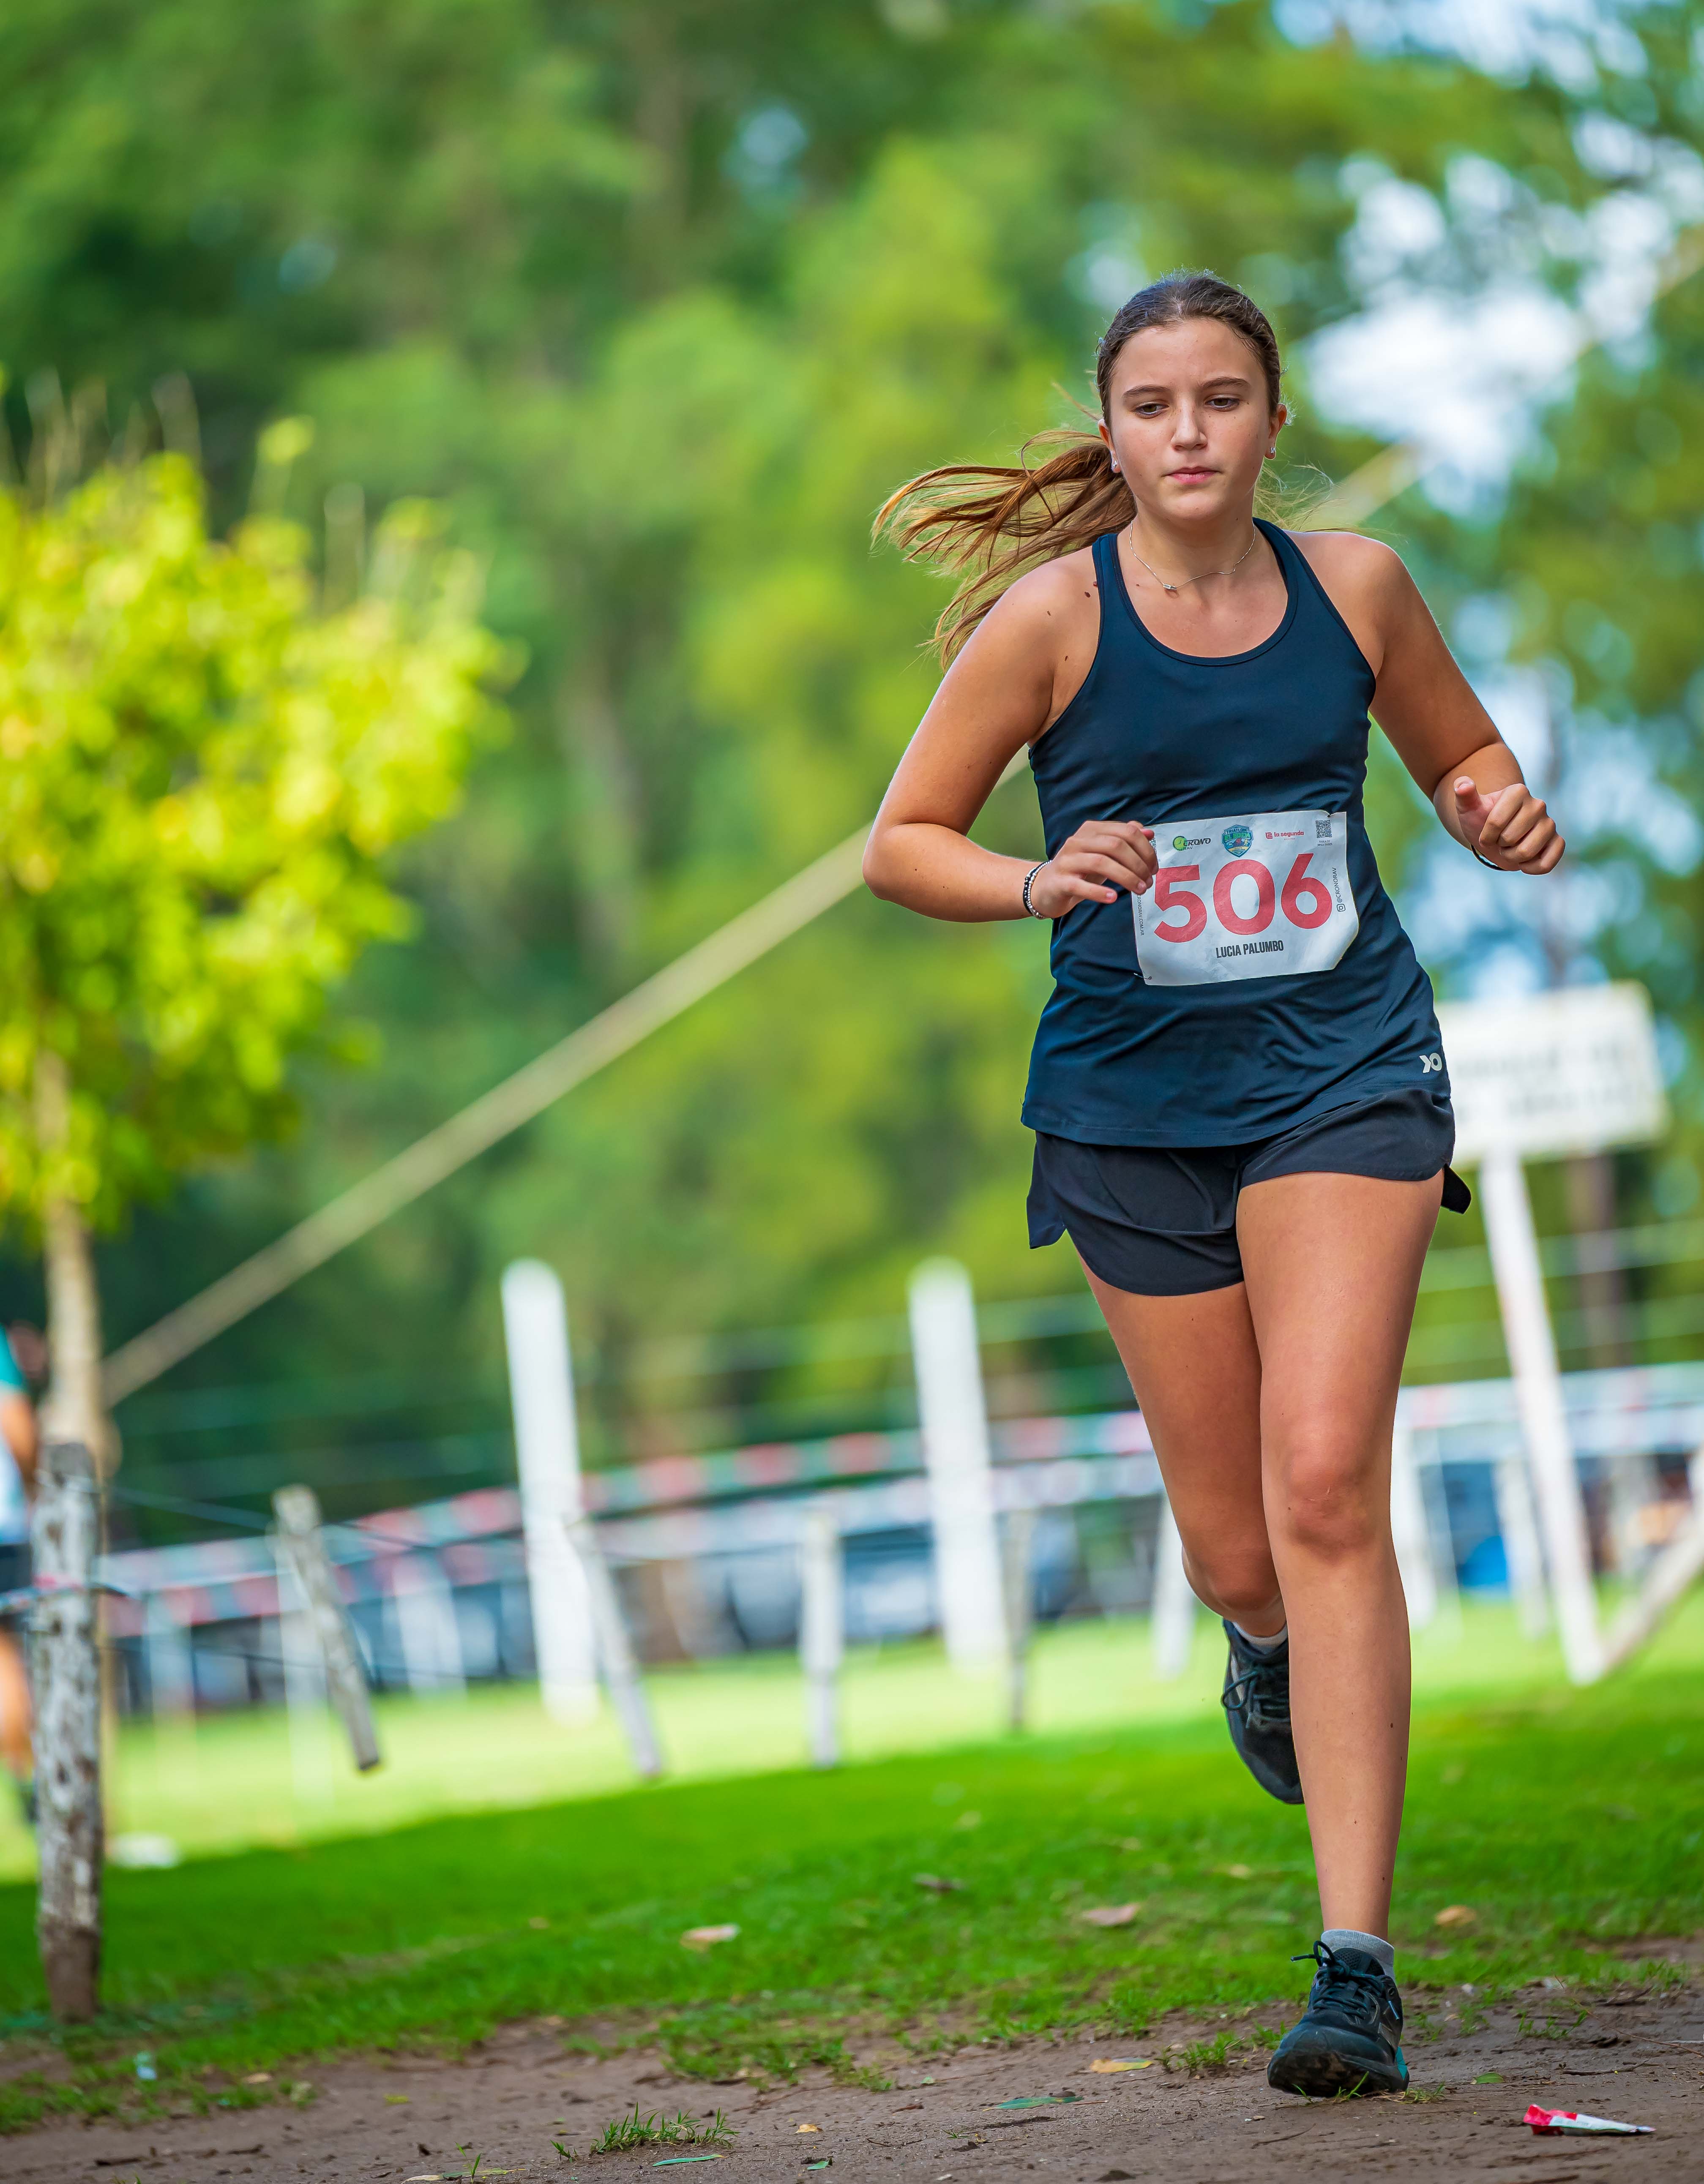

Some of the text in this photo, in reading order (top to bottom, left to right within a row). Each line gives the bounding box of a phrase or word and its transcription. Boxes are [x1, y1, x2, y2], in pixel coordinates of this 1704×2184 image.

[1183, 838, 1211, 846] CRONO
[1154, 853, 1332, 943] 506
[1332, 867, 1342, 903] @CRONORAV
[1215, 940, 1284, 958] LUCIA PALUMBO
